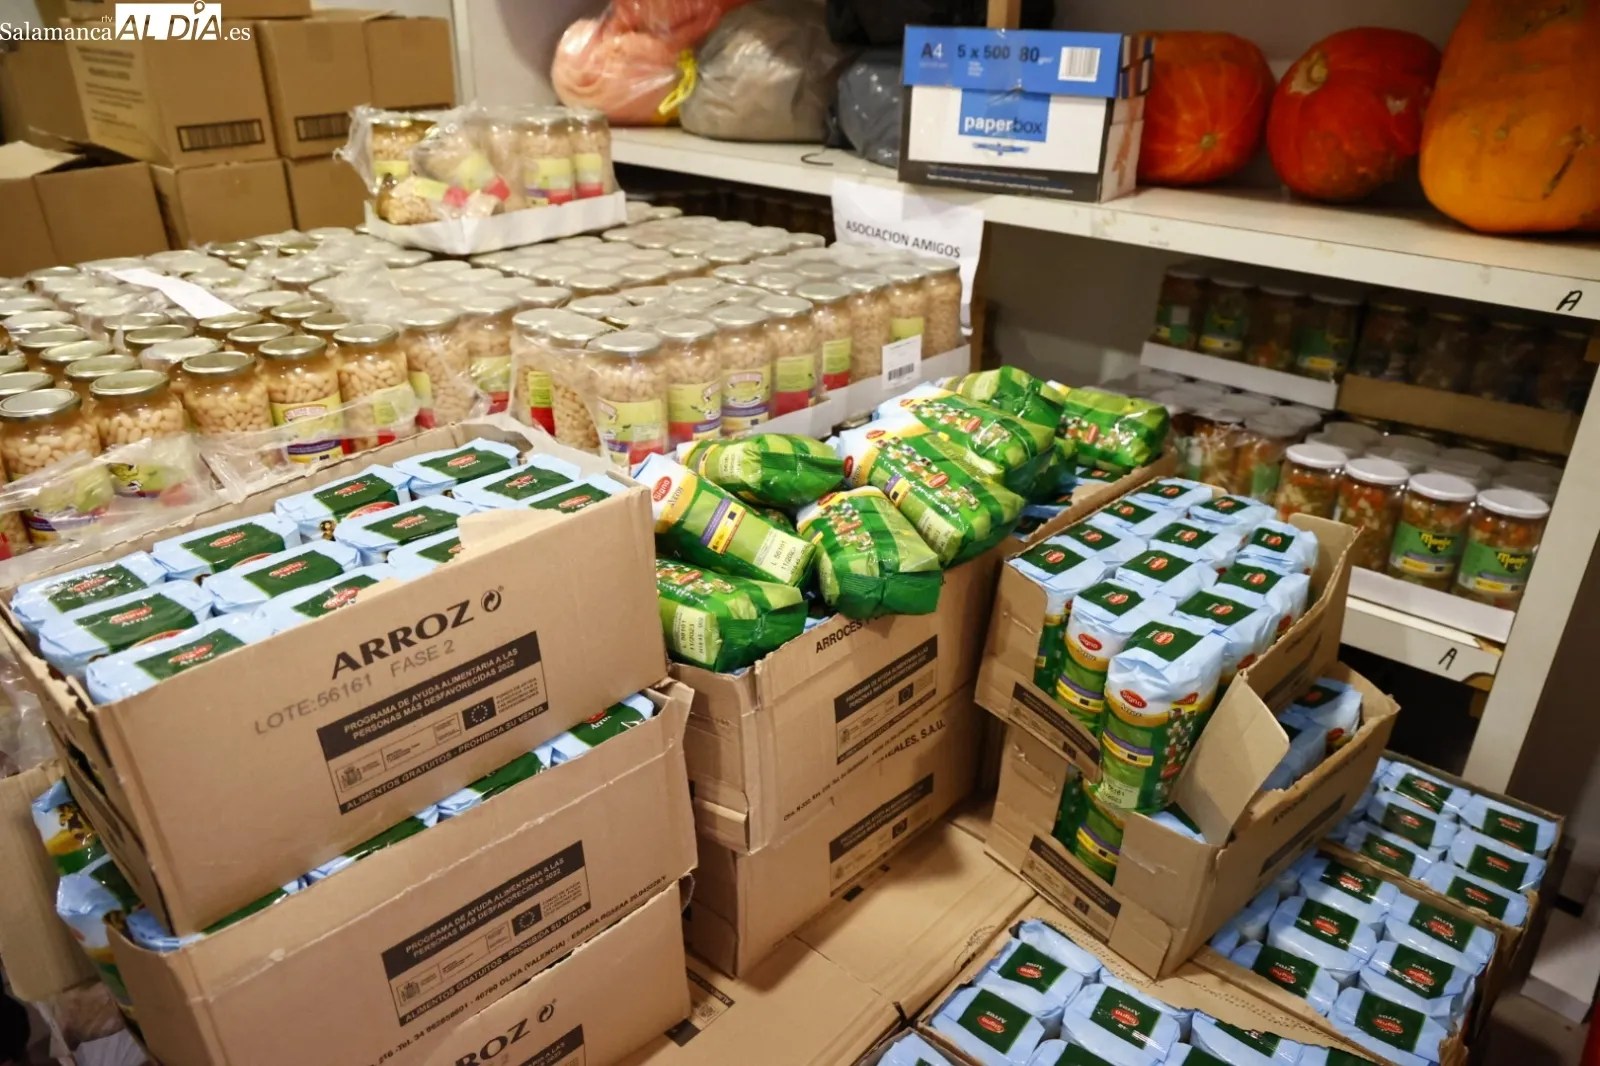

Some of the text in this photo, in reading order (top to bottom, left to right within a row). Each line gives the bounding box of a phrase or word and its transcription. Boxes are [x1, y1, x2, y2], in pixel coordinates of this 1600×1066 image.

[921, 42, 943, 60] A4
[957, 44, 1011, 59] 5 x 500
[964, 116, 1042, 133] paperbox
[845, 219, 961, 258] ASOCIACION AMIGOS
[1556, 290, 1583, 312] A
[330, 599, 475, 680] ARROZ
[815, 620, 863, 654] ARROCES
[1438, 648, 1461, 670] A
[254, 639, 455, 737] LOTE:56161 FASE 2
[344, 704, 397, 734] PROGRAMA
[398, 698, 410, 709] DE
[411, 684, 441, 702] AYUDA
[441, 659, 494, 689] ALIMENTARIA
[501, 647, 519, 661] LAS
[352, 712, 402, 741] PERSONAS
[423, 669, 497, 708] DESFAVORECIDAS
[497, 659, 516, 673] 2022
[346, 778, 400, 810] ALIMENTOS
[401, 753, 453, 783] GRATUITOS
[458, 727, 505, 754] PROHIBIDA
[505, 719, 517, 731] SU
[517, 706, 545, 725] VENTA
[405, 921, 454, 953] PROGRAMA
[454, 915, 467, 926] DE
[467, 899, 494, 917] AYUDA
[494, 871, 543, 903] ALIMENTARIA
[550, 857, 565, 870] LAS
[413, 929, 458, 959] PERSONAS
[477, 878, 545, 920] DESFAVORECIDAS
[544, 868, 562, 882] 2022
[404, 988, 456, 1023] ALIMENTOS
[456, 957, 503, 993] GRATUITOS
[507, 928, 551, 961] PROHIBIDA
[551, 920, 563, 933] SU
[562, 905, 587, 925] VENTA
[499, 969, 524, 986] OLIVA
[523, 939, 567, 971] (VALENCIA)
[571, 918, 600, 940] ESPAÑA
[455, 1018, 531, 1066] ROZ
